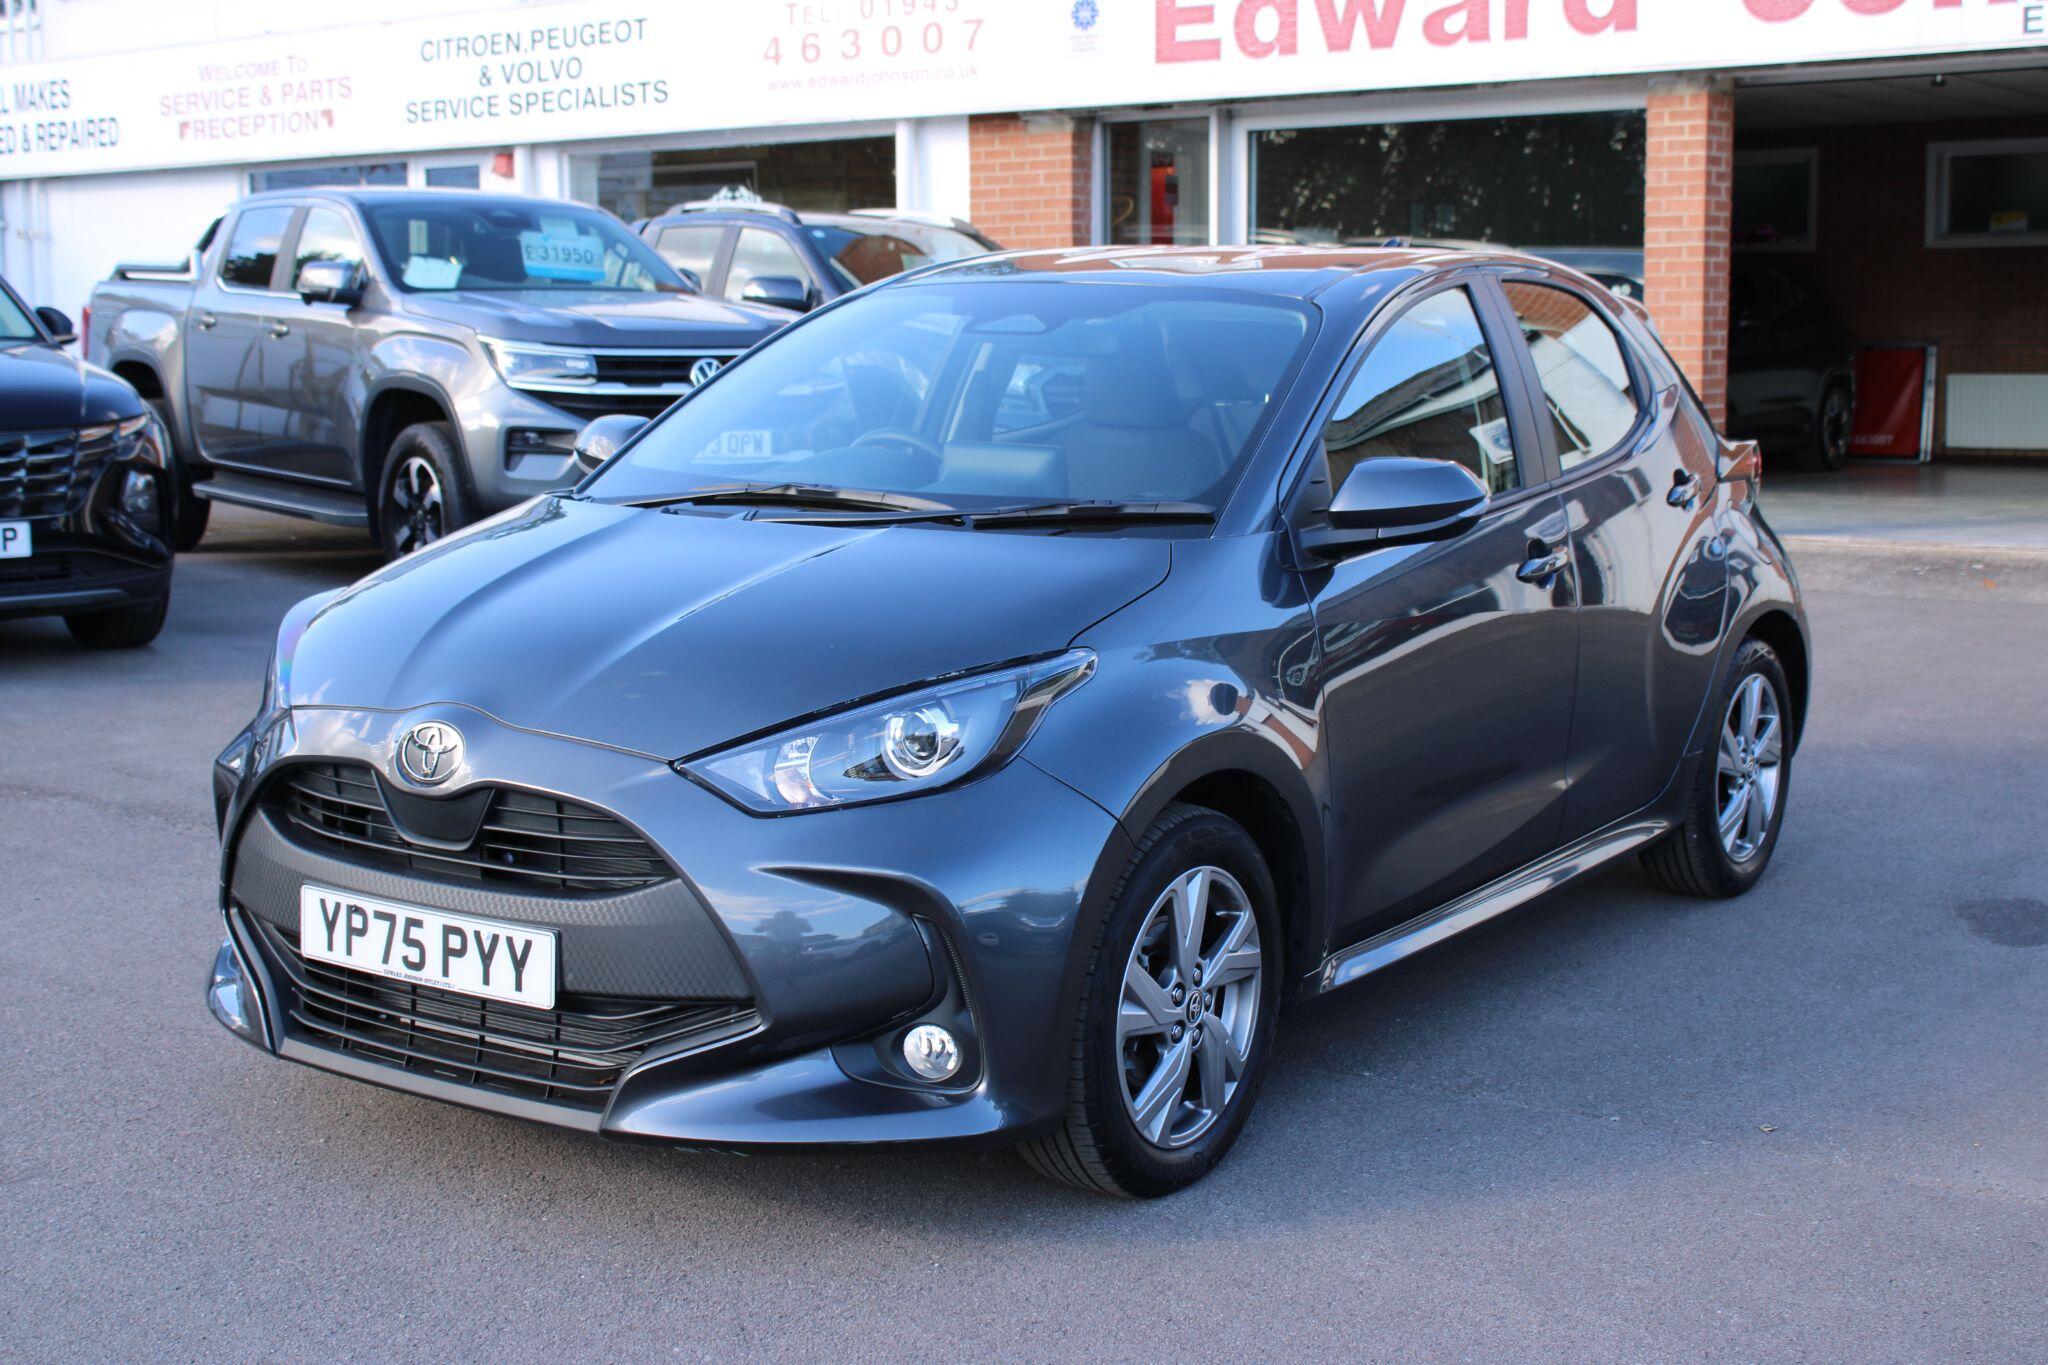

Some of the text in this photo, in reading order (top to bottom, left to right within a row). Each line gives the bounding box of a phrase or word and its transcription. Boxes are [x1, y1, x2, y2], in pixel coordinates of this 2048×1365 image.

[479, 56, 582, 87] & VOLVO
[14, 79, 71, 112] MAKES
[160, 76, 353, 118] SERVICE & PARTS
[406, 80, 669, 124] SERVICE SPECIALISTS
[36, 117, 120, 151] REPAIRED
[194, 110, 320, 141] RECEPTION
[320, 898, 533, 993] YP75 PYY
